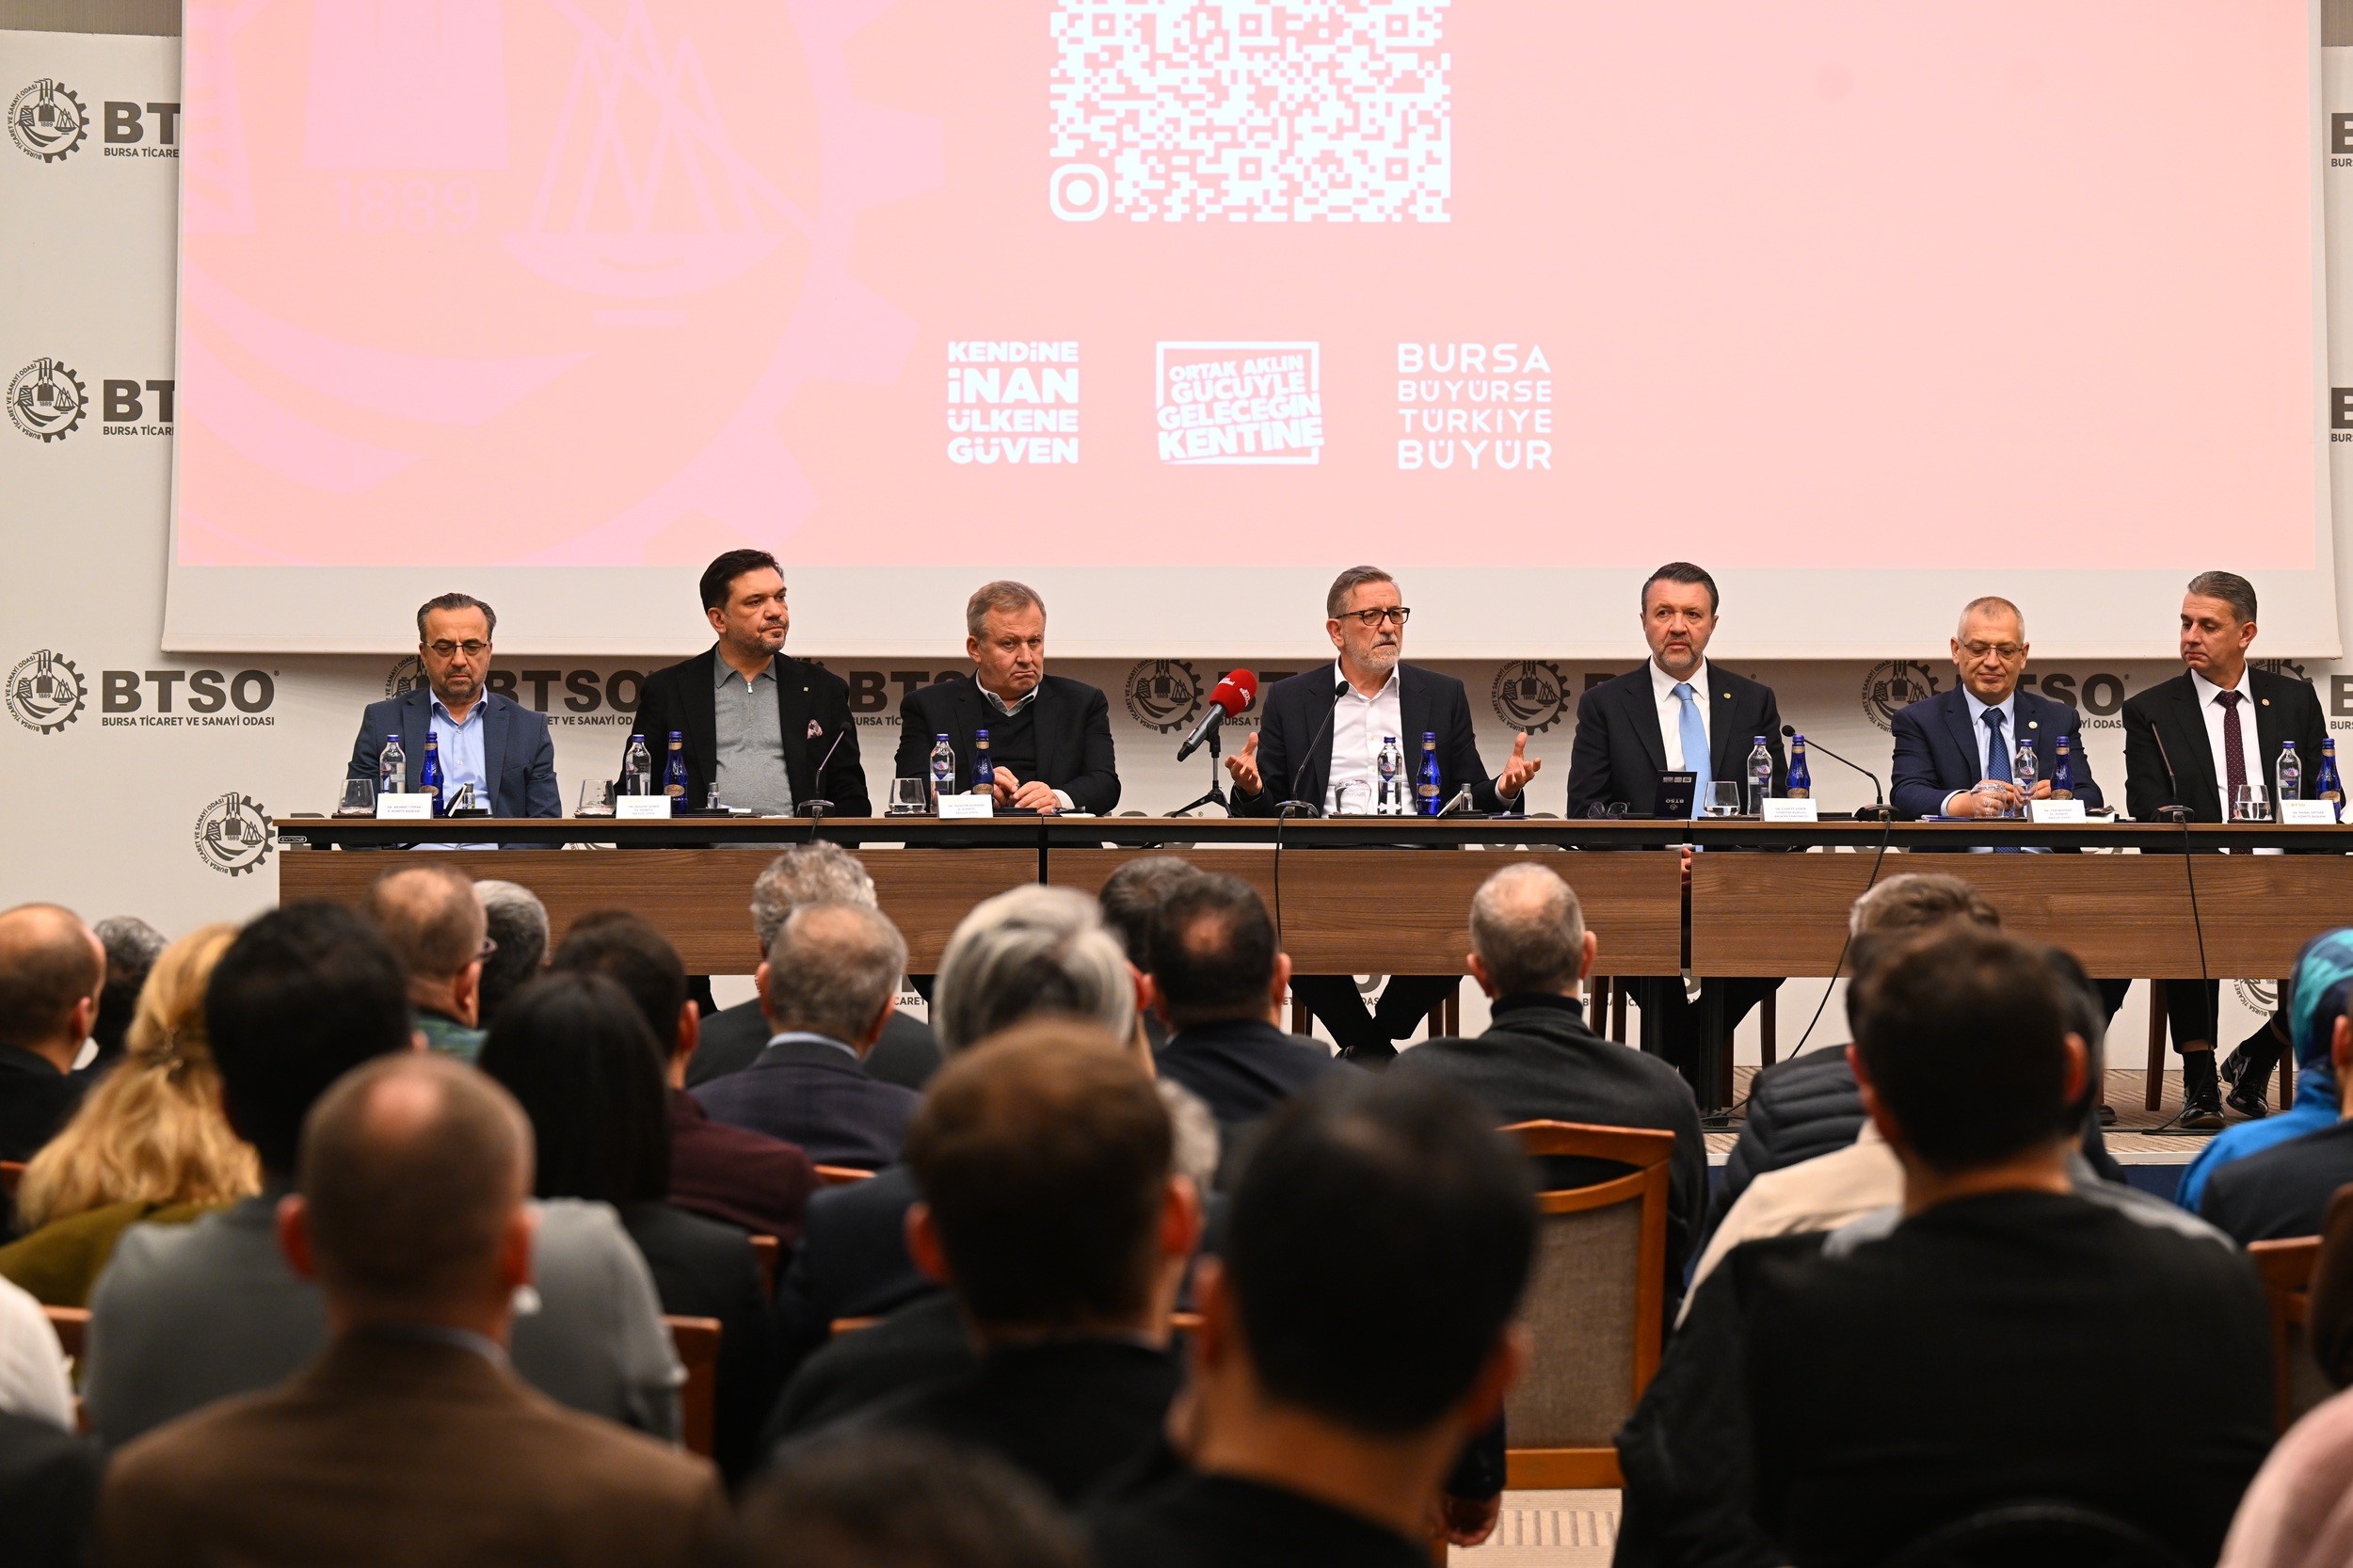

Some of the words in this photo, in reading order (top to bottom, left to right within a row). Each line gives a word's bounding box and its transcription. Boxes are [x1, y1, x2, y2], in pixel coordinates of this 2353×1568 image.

[21, 84, 38, 96] ODASI
[8, 116, 13, 124] VE
[104, 101, 181, 145] BT
[24, 148, 42, 160] BURSA
[104, 147, 138, 157] BURSA
[141, 146, 180, 158] TİCARE
[2330, 158, 2353, 168] BUR
[331, 177, 480, 234] 1889
[1398, 343, 1551, 374] BURSA
[19, 363, 37, 376] ODASI
[1169, 360, 1238, 382] ORTAK
[1242, 355, 1304, 376] AKLIN
[1398, 380, 1552, 402] BÜYÜRSE
[7, 396, 12, 405] VE
[103, 379, 175, 423] BT
[948, 408, 1079, 433] ÜLKENE
[1398, 408, 1552, 433] TÜRKİYE
[23, 426, 40, 440] BURSA
[103, 426, 137, 436] BURSA
[140, 424, 173, 436] TİCAR
[2330, 433, 2352, 442] BUR
[947, 437, 1079, 464] GÜVEN
[1398, 440, 1552, 470] BÜYÜR
[19, 655, 36, 668] ODASI
[103, 669, 275, 713] BTSO
[21, 719, 40, 731] BURSA
[102, 717, 136, 727] BURSA
[139, 715, 183, 727] TİCARET
[186, 716, 200, 727] VE
[201, 715, 240, 727] SANAYİ
[242, 716, 275, 727] ODASI
[562, 716, 575, 725] VE
[577, 714, 615, 726] SANAYİ
[207, 798, 225, 811] ODASI
[194, 808, 208, 830] SANAYİ
[194, 831, 200, 840] VE
[194, 841, 210, 864] TİCARET
[209, 861, 229, 873] BURSA
[2249, 1004, 2267, 1016] BURSA
